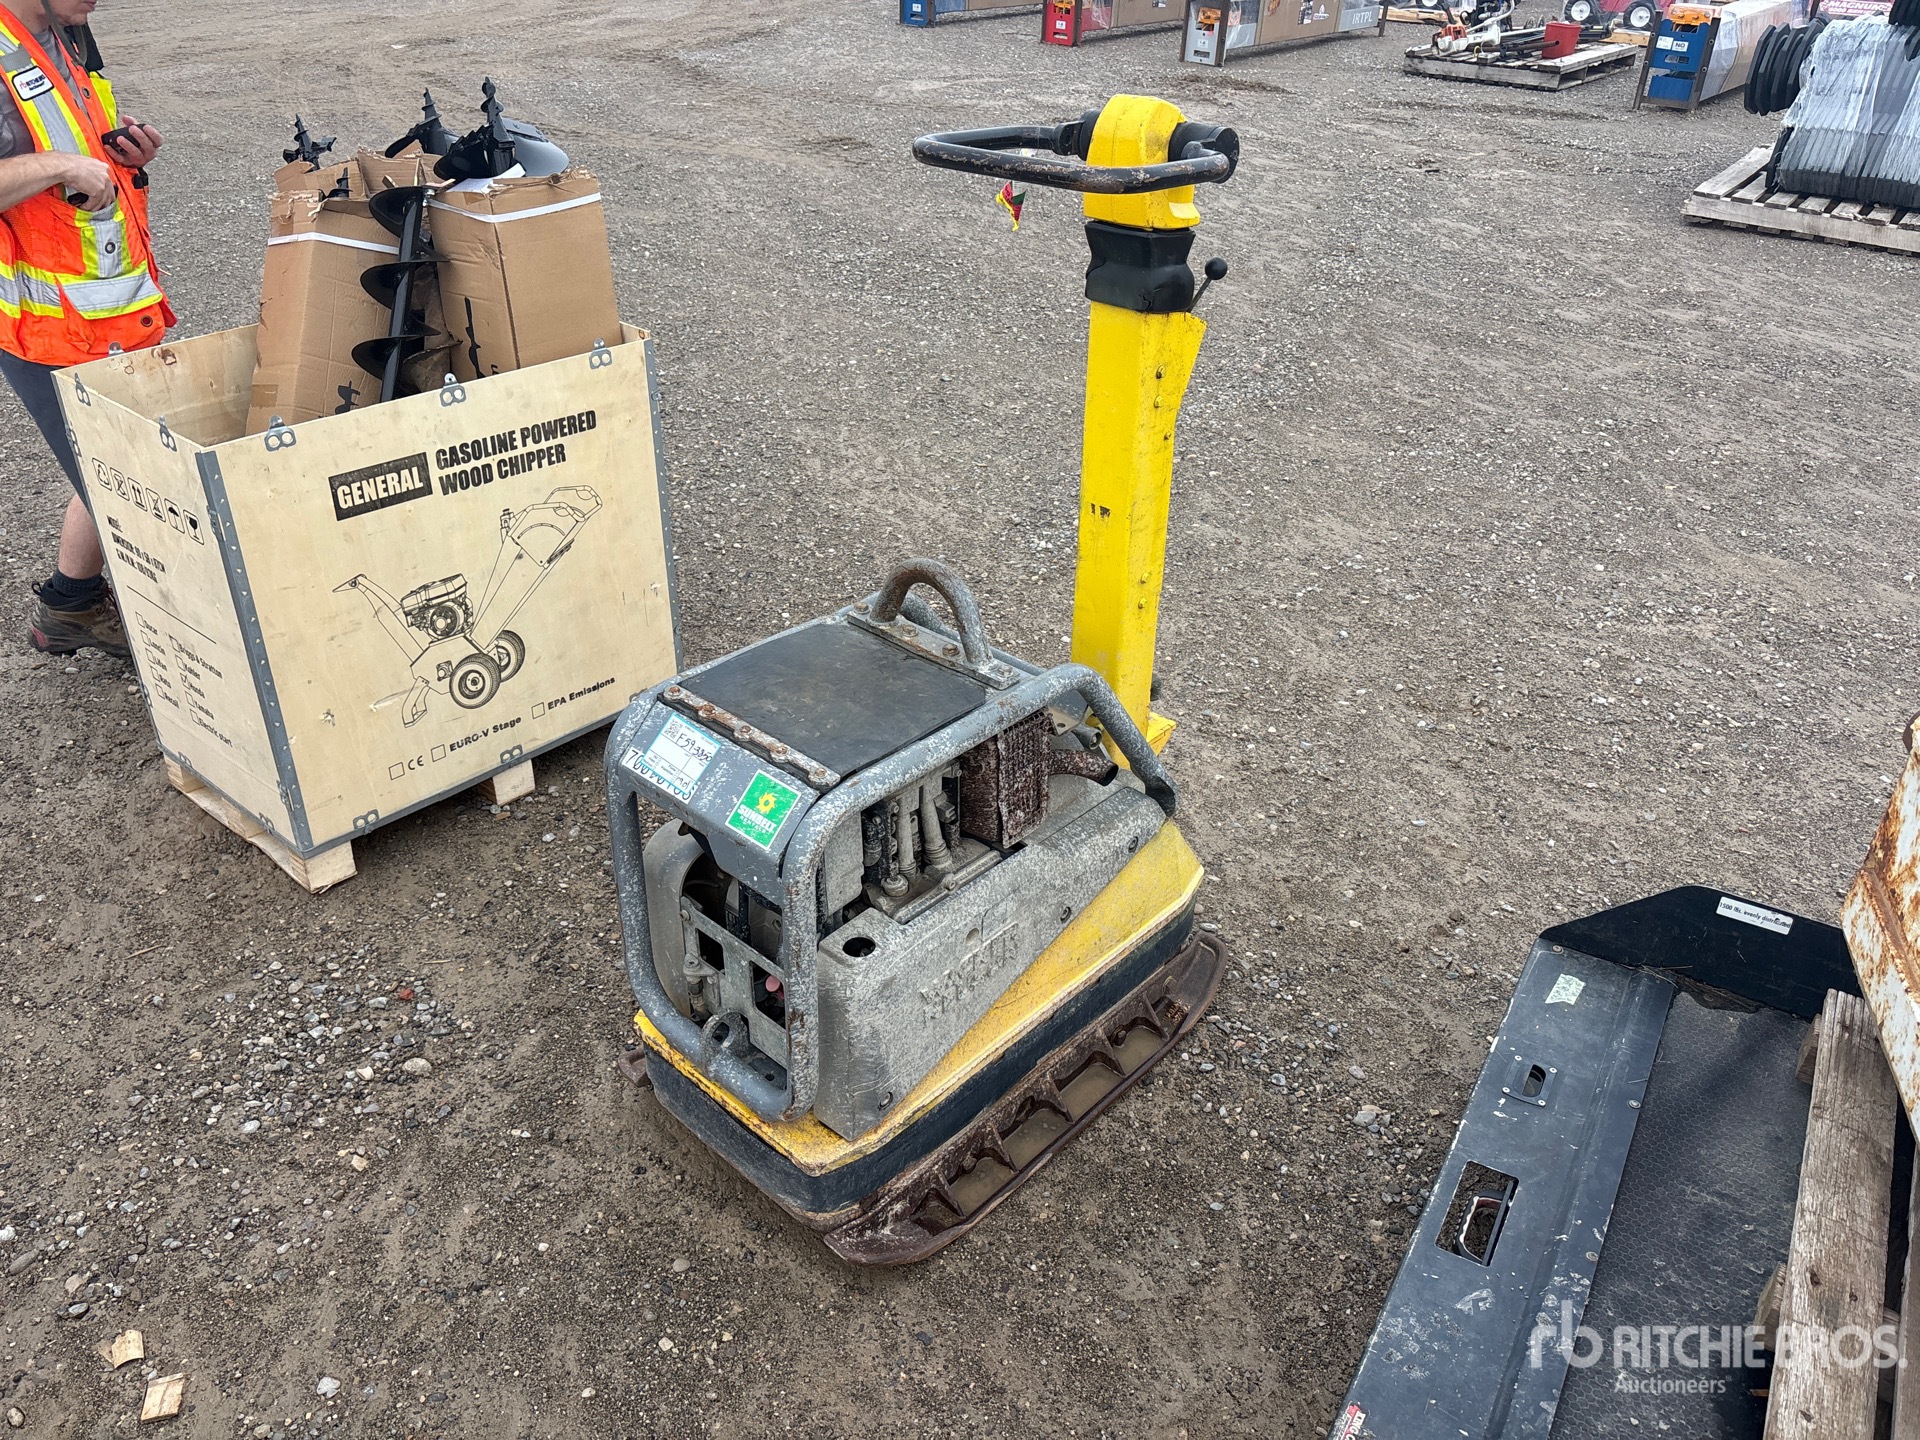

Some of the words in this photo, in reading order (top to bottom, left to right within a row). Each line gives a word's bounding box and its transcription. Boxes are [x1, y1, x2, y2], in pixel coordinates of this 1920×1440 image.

[1828, 0, 1880, 10] MAGNUM
[435, 429, 517, 470] GASOLINE
[520, 409, 597, 447] POWERED
[438, 462, 494, 496] WOOD
[496, 443, 567, 480] CHIPPER
[337, 466, 425, 509] GENERAL
[179, 643, 196, 662] Briggs
[199, 657, 223, 679] Stratton
[188, 681, 206, 699] Honda
[547, 697, 567, 711] EPA
[568, 676, 616, 701] Emissions
[218, 731, 233, 748] start
[492, 715, 522, 734] Stage
[737, 803, 777, 833] SUNBELT
[1743, 910, 1761, 920] evenly
